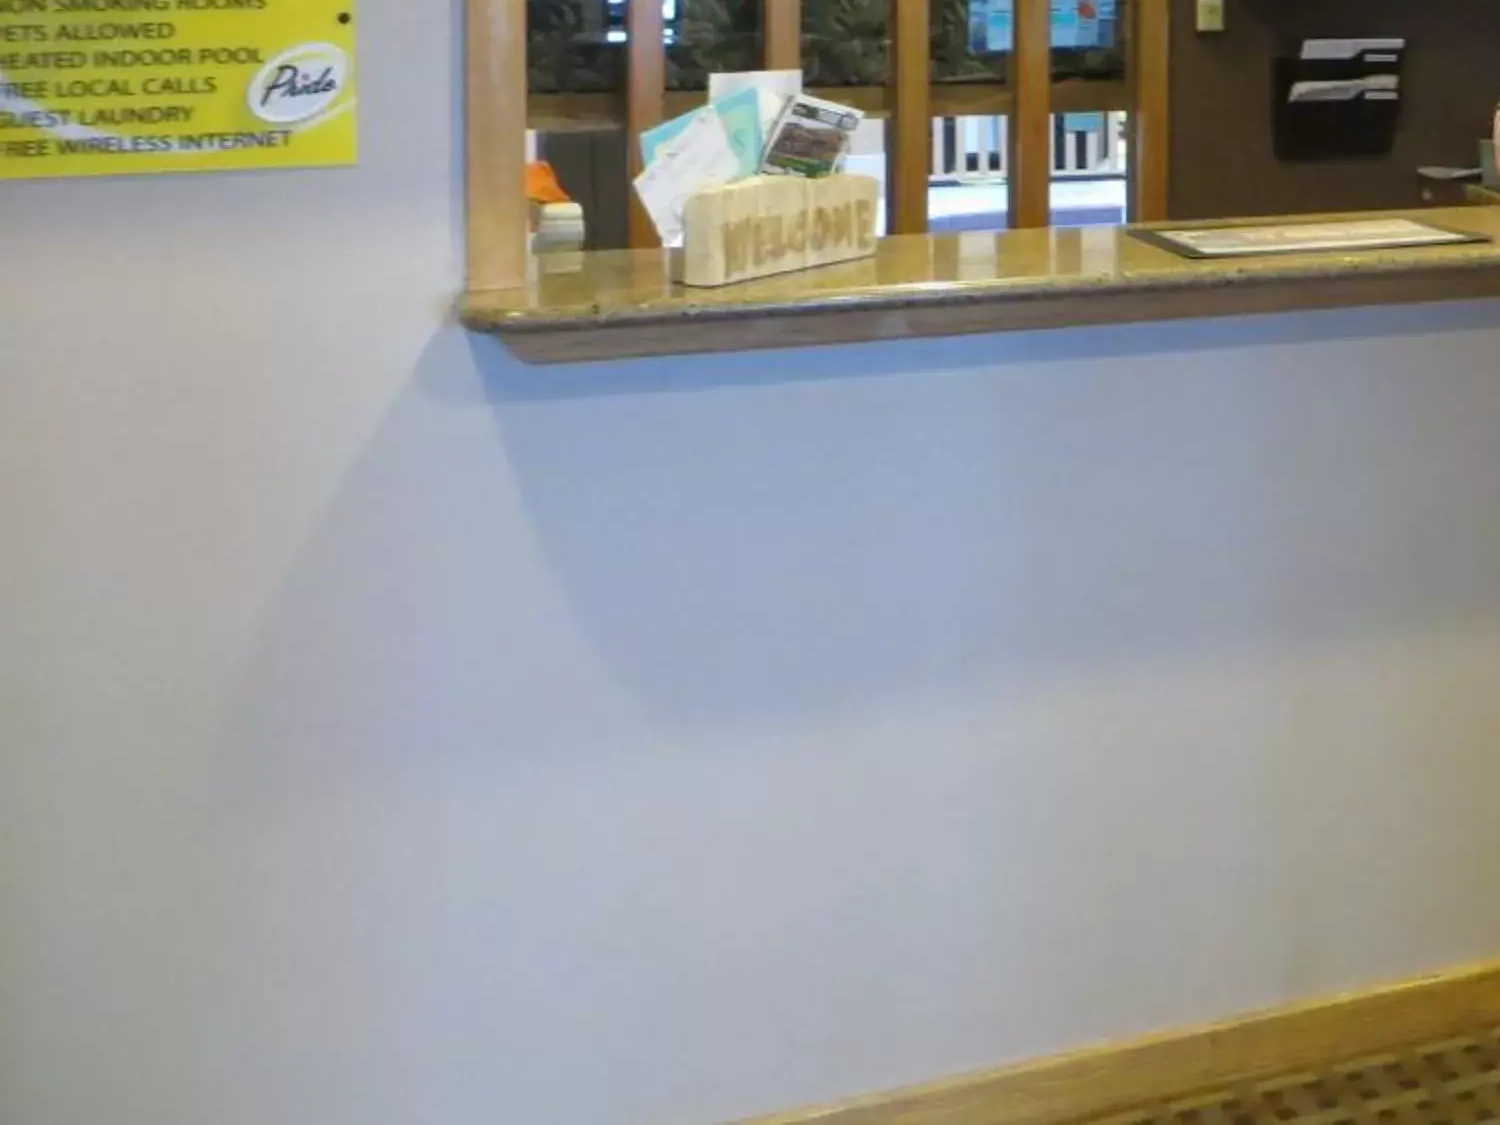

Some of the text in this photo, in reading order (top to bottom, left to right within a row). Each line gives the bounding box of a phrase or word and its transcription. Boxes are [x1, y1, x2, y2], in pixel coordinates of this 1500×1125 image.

[0, 21, 176, 42] ETS ALLOWED
[94, 48, 192, 67] INDOOR
[198, 46, 265, 64] POOL
[0, 75, 218, 99] REE LOCAL CALLS
[78, 106, 194, 126] LAUNDRY
[0, 128, 292, 157] REE WIRELESS INTERNET
[723, 197, 873, 277] WELCOME
